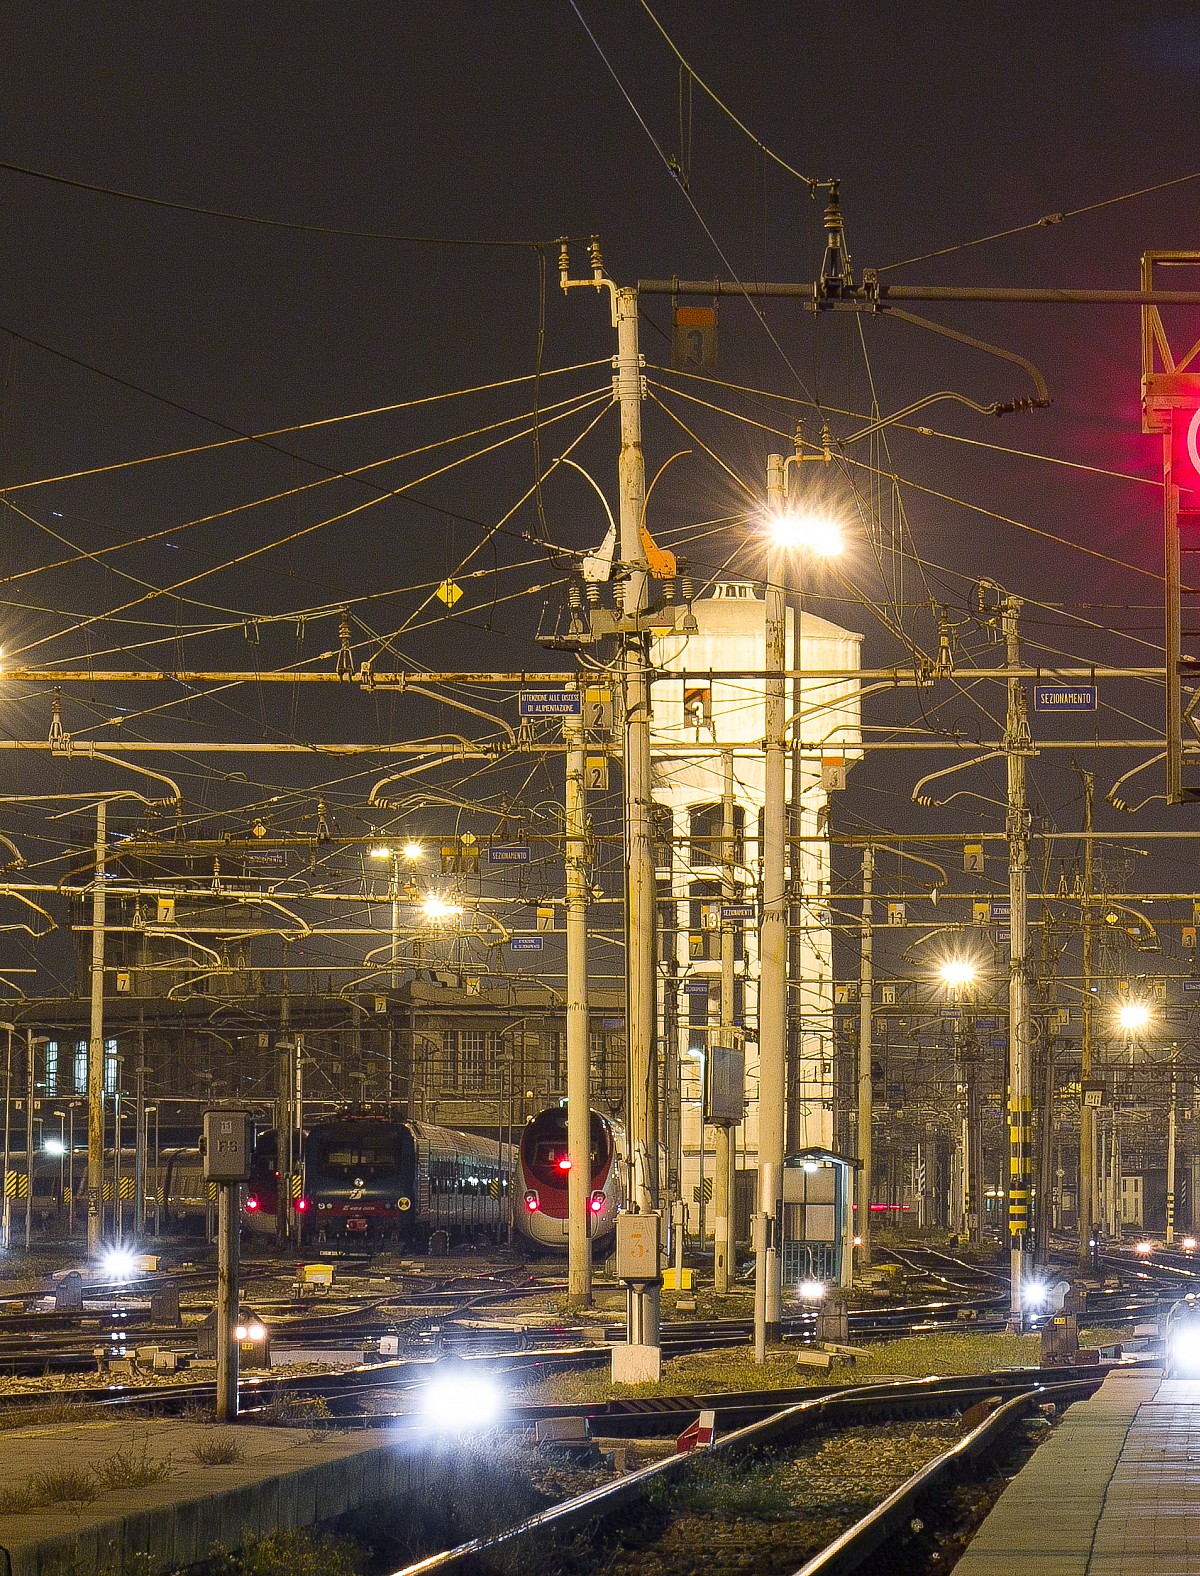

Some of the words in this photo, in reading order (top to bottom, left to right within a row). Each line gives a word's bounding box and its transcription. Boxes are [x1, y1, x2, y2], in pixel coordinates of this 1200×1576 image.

[521, 694, 548, 702] ATTENZIONE
[549, 694, 560, 702] ALLE
[562, 693, 580, 702] DISCESE
[1040, 692, 1092, 705] SEZIONAMENTO
[528, 704, 534, 712] DI
[536, 704, 574, 712] ALIMENTAZIONE
[692, 701, 704, 727] 3
[592, 703, 604, 728] 2
[592, 768, 601, 788] 2
[828, 767, 838, 787] 3
[492, 851, 527, 860] SEZIONAMENTO
[970, 855, 978, 870] 2
[163, 908, 170, 921] 7
[723, 909, 753, 917] SEZIONAMENTO
[890, 911, 903, 924] 13
[543, 917, 549, 930] 7
[703, 912, 717, 928] 13
[1185, 935, 1192, 946] 3
[692, 943, 699, 955] 7
[120, 980, 126, 990] 7
[470, 984, 476, 994] 7
[839, 992, 845, 1003] 7
[883, 992, 894, 1003] 13
[378, 1002, 384, 1011] 7
